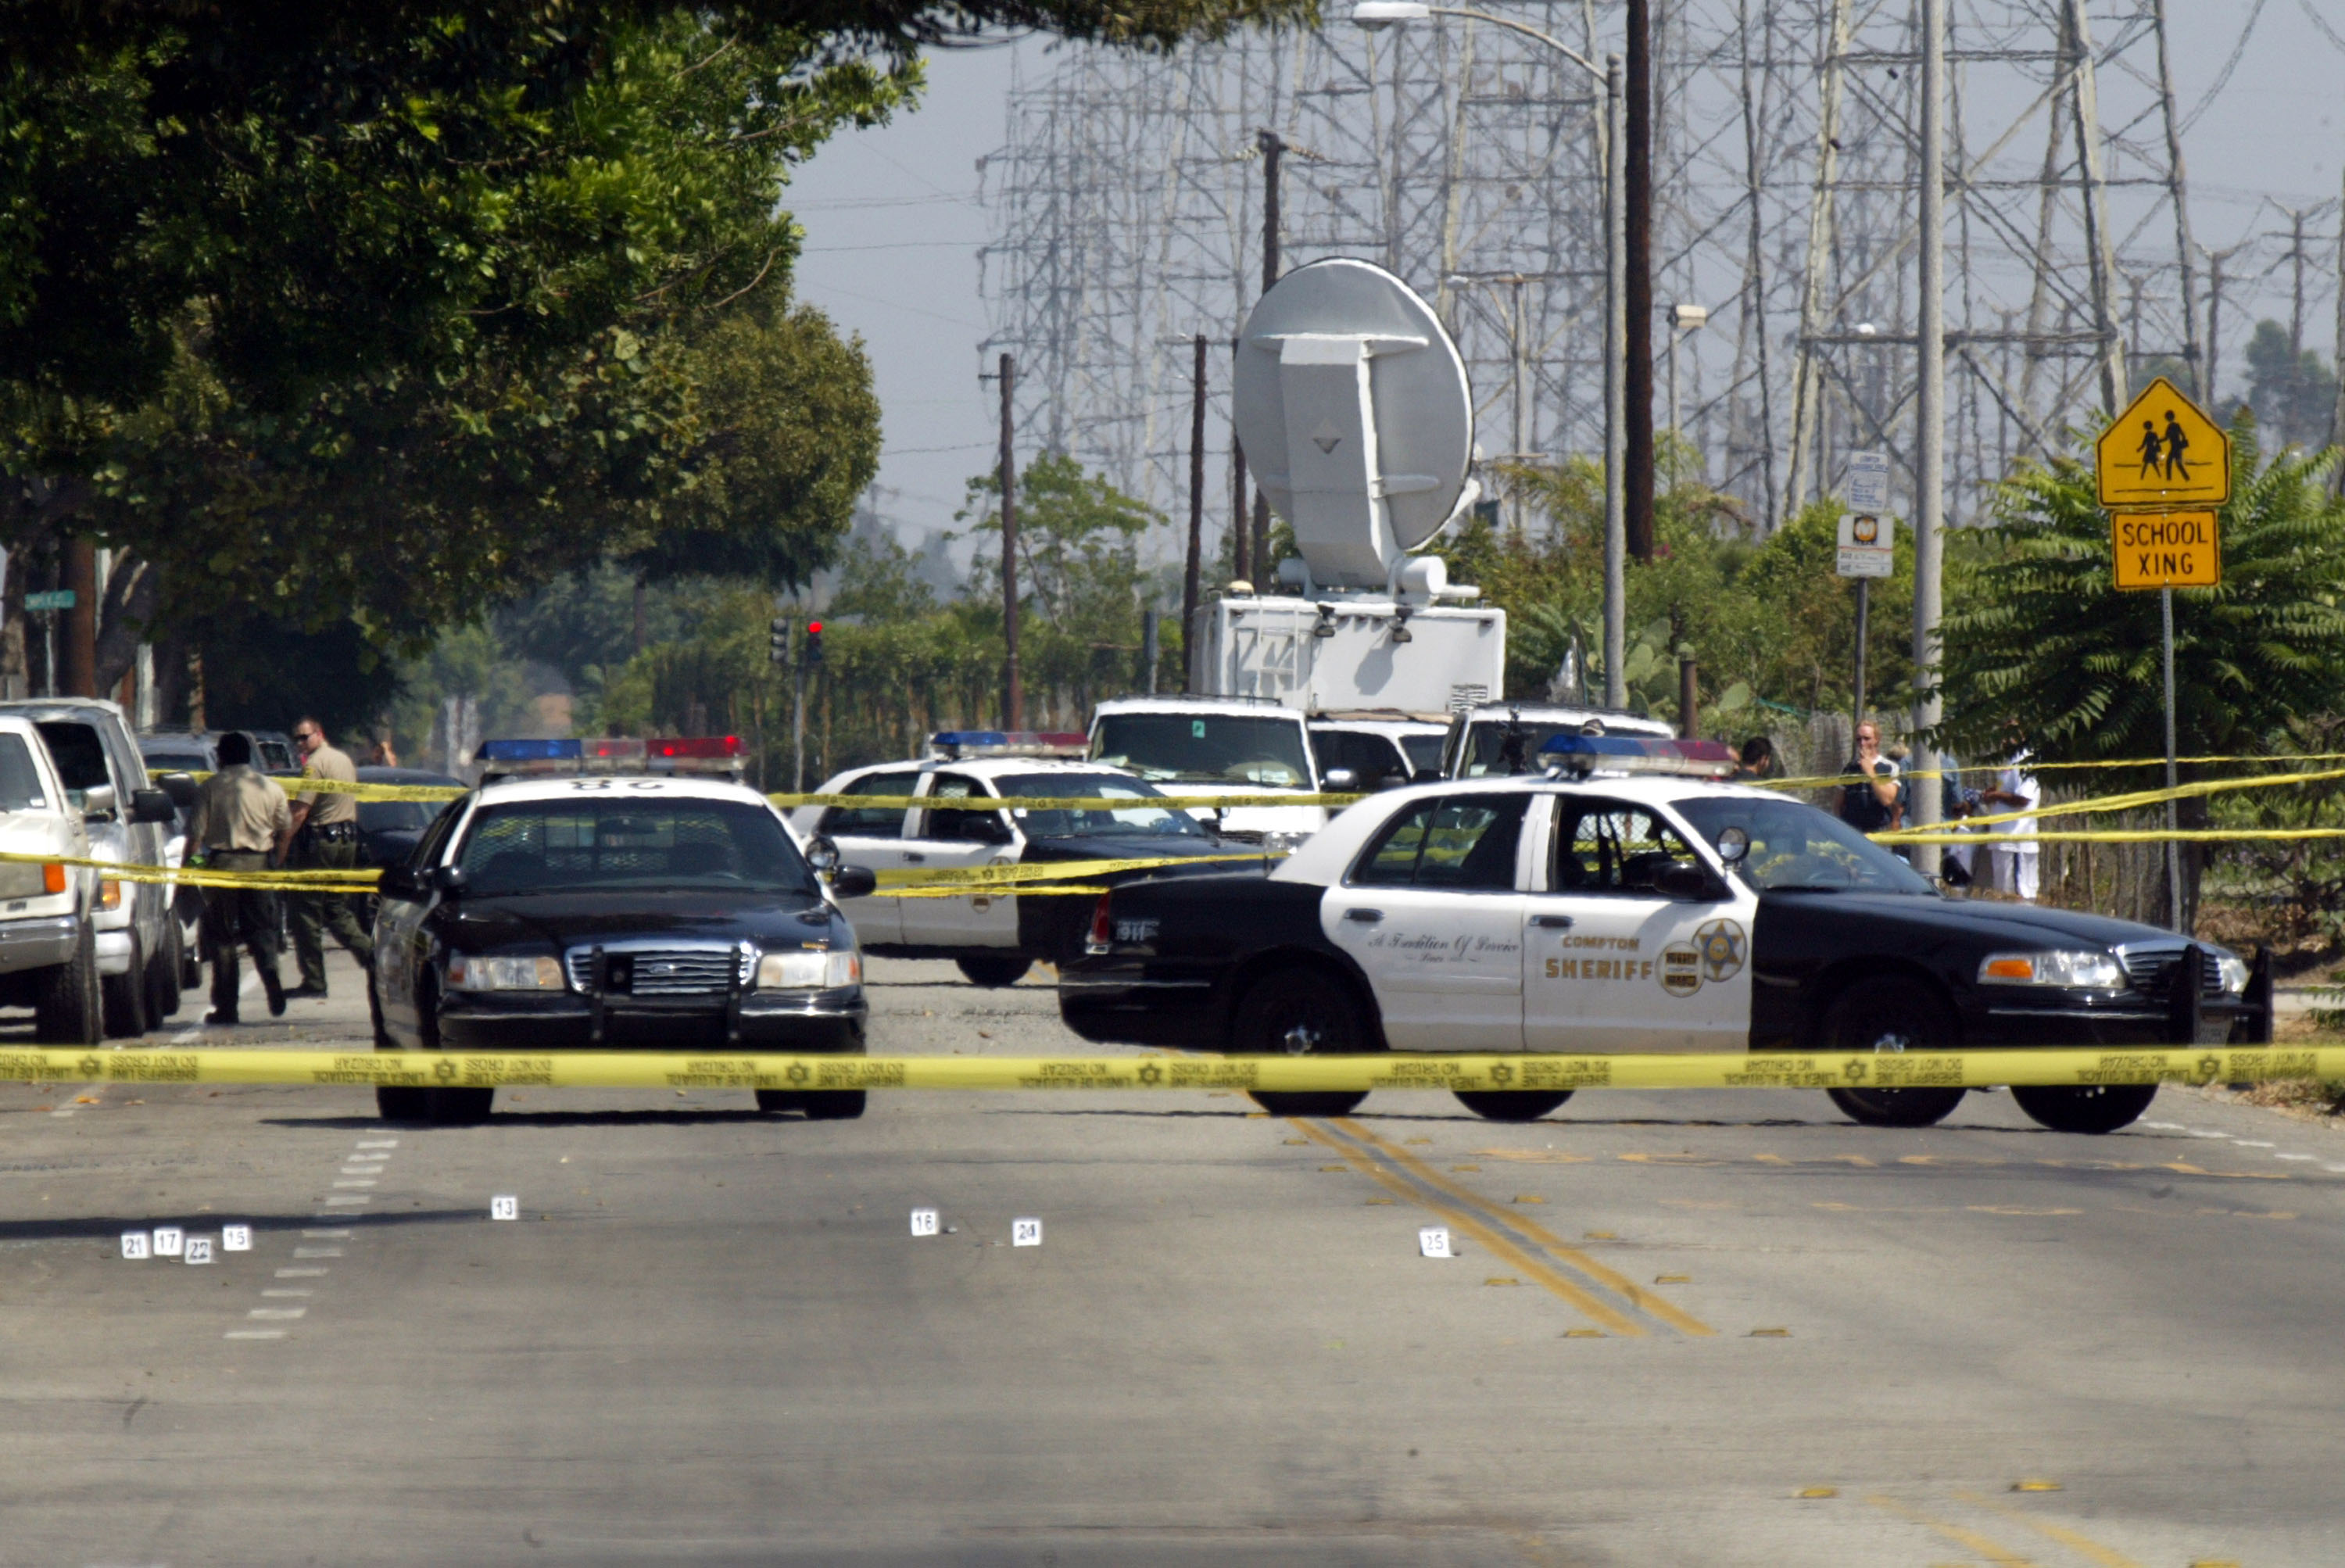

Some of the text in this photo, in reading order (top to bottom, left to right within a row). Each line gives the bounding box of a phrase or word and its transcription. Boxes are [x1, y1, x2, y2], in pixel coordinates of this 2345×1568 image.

[2122, 521, 2209, 546] SCHOOL
[2138, 553, 2194, 576] XING
[1562, 936, 1640, 951] COMPTON
[1545, 958, 1652, 980] SHERIFF
[496, 1200, 513, 1215] 13
[126, 1237, 142, 1255] 21
[159, 1233, 177, 1250] 17
[227, 1231, 245, 1246] 15
[1427, 1233, 1444, 1251] 25
[189, 1242, 209, 1260] 22
